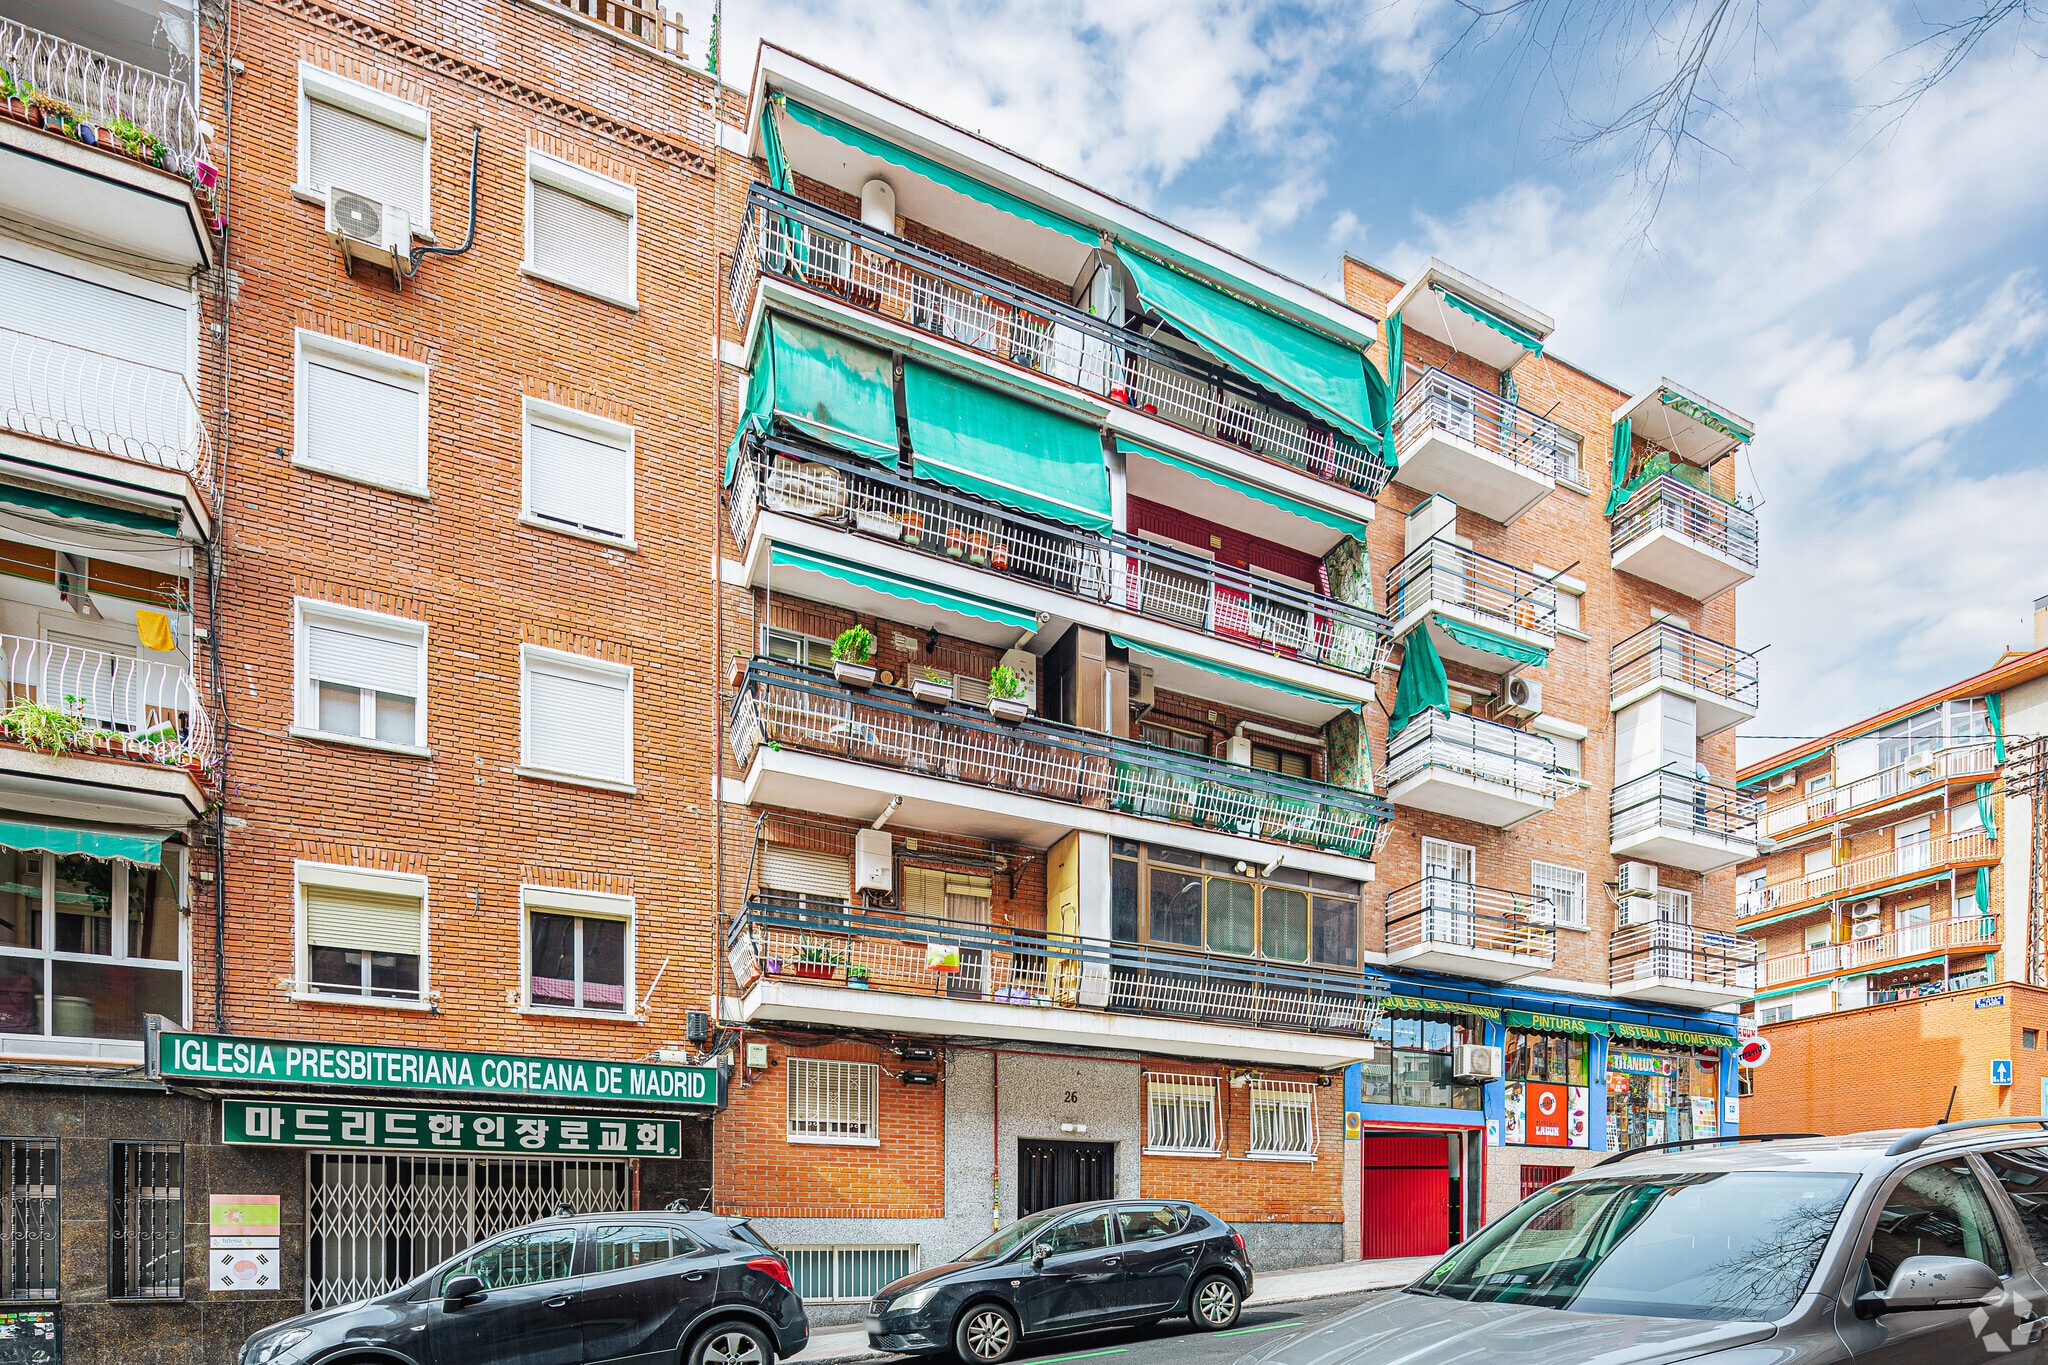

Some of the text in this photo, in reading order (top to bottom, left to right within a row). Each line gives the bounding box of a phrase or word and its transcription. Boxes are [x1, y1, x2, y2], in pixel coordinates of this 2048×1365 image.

[1532, 1014, 1586, 1032] PINTURAS
[1619, 1024, 1733, 1047] SISTEMA TINTOMETRICO
[1738, 1042, 1767, 1061] TITANLUX
[174, 1038, 706, 1099] IGLESIA PRESBITERIANA COREANA DE MADRID
[1613, 1053, 1656, 1073] TITANLUX
[1064, 1090, 1078, 1103] 26
[245, 1106, 665, 1154] 마드리드한인장로교회
